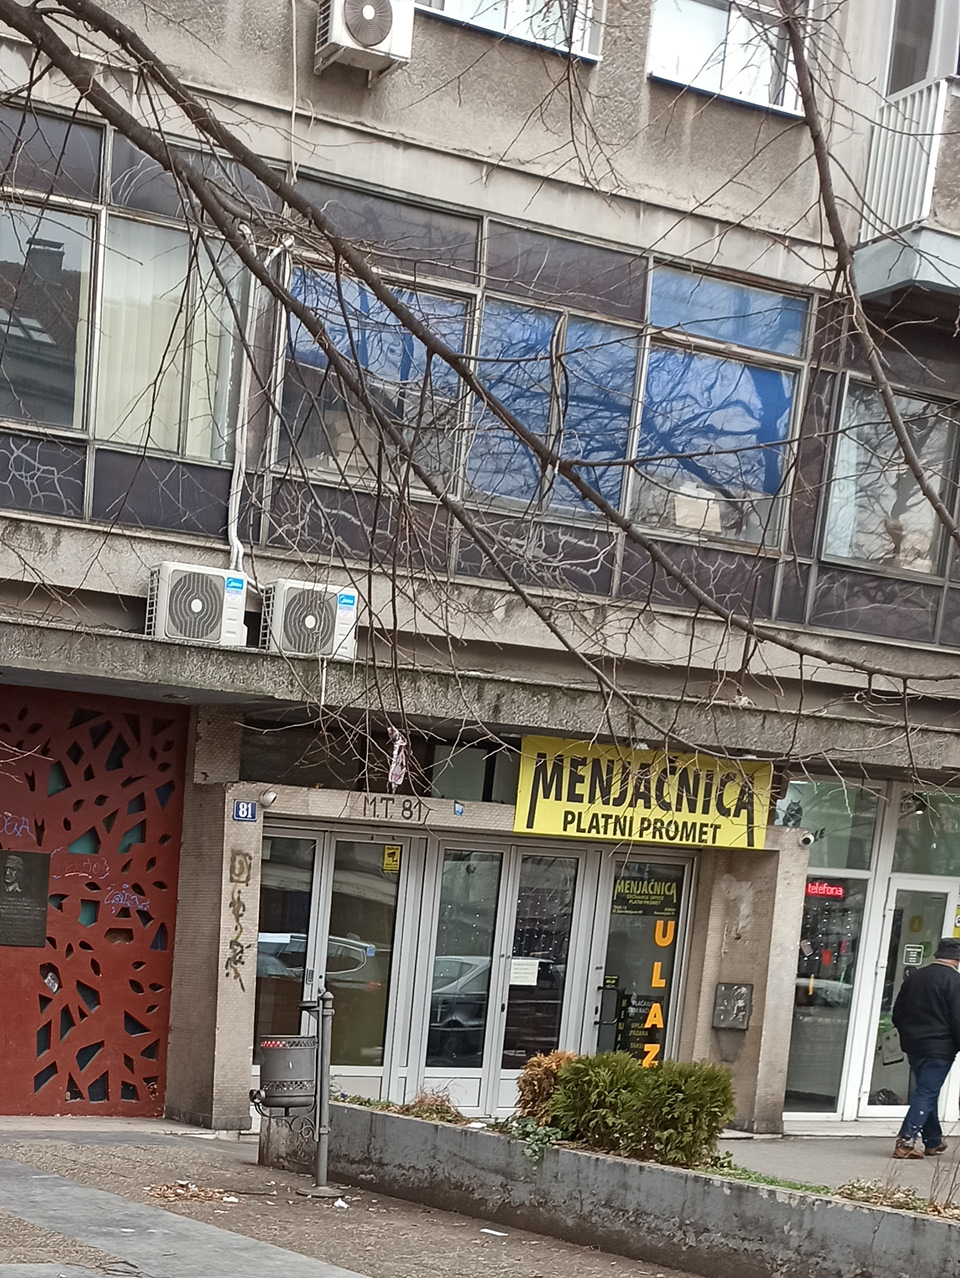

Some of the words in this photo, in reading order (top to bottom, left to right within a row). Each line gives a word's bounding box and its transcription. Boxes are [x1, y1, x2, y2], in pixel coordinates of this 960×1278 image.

[239, 802, 253, 819] 81
[401, 798, 423, 821] 81
[526, 752, 755, 847] MENJAČNICA
[562, 810, 634, 838] PLATNI
[639, 816, 722, 844] PROMET
[613, 879, 677, 903] MENJAČNICA
[807, 882, 844, 896] telefona
[641, 919, 676, 1069] ULAZ
